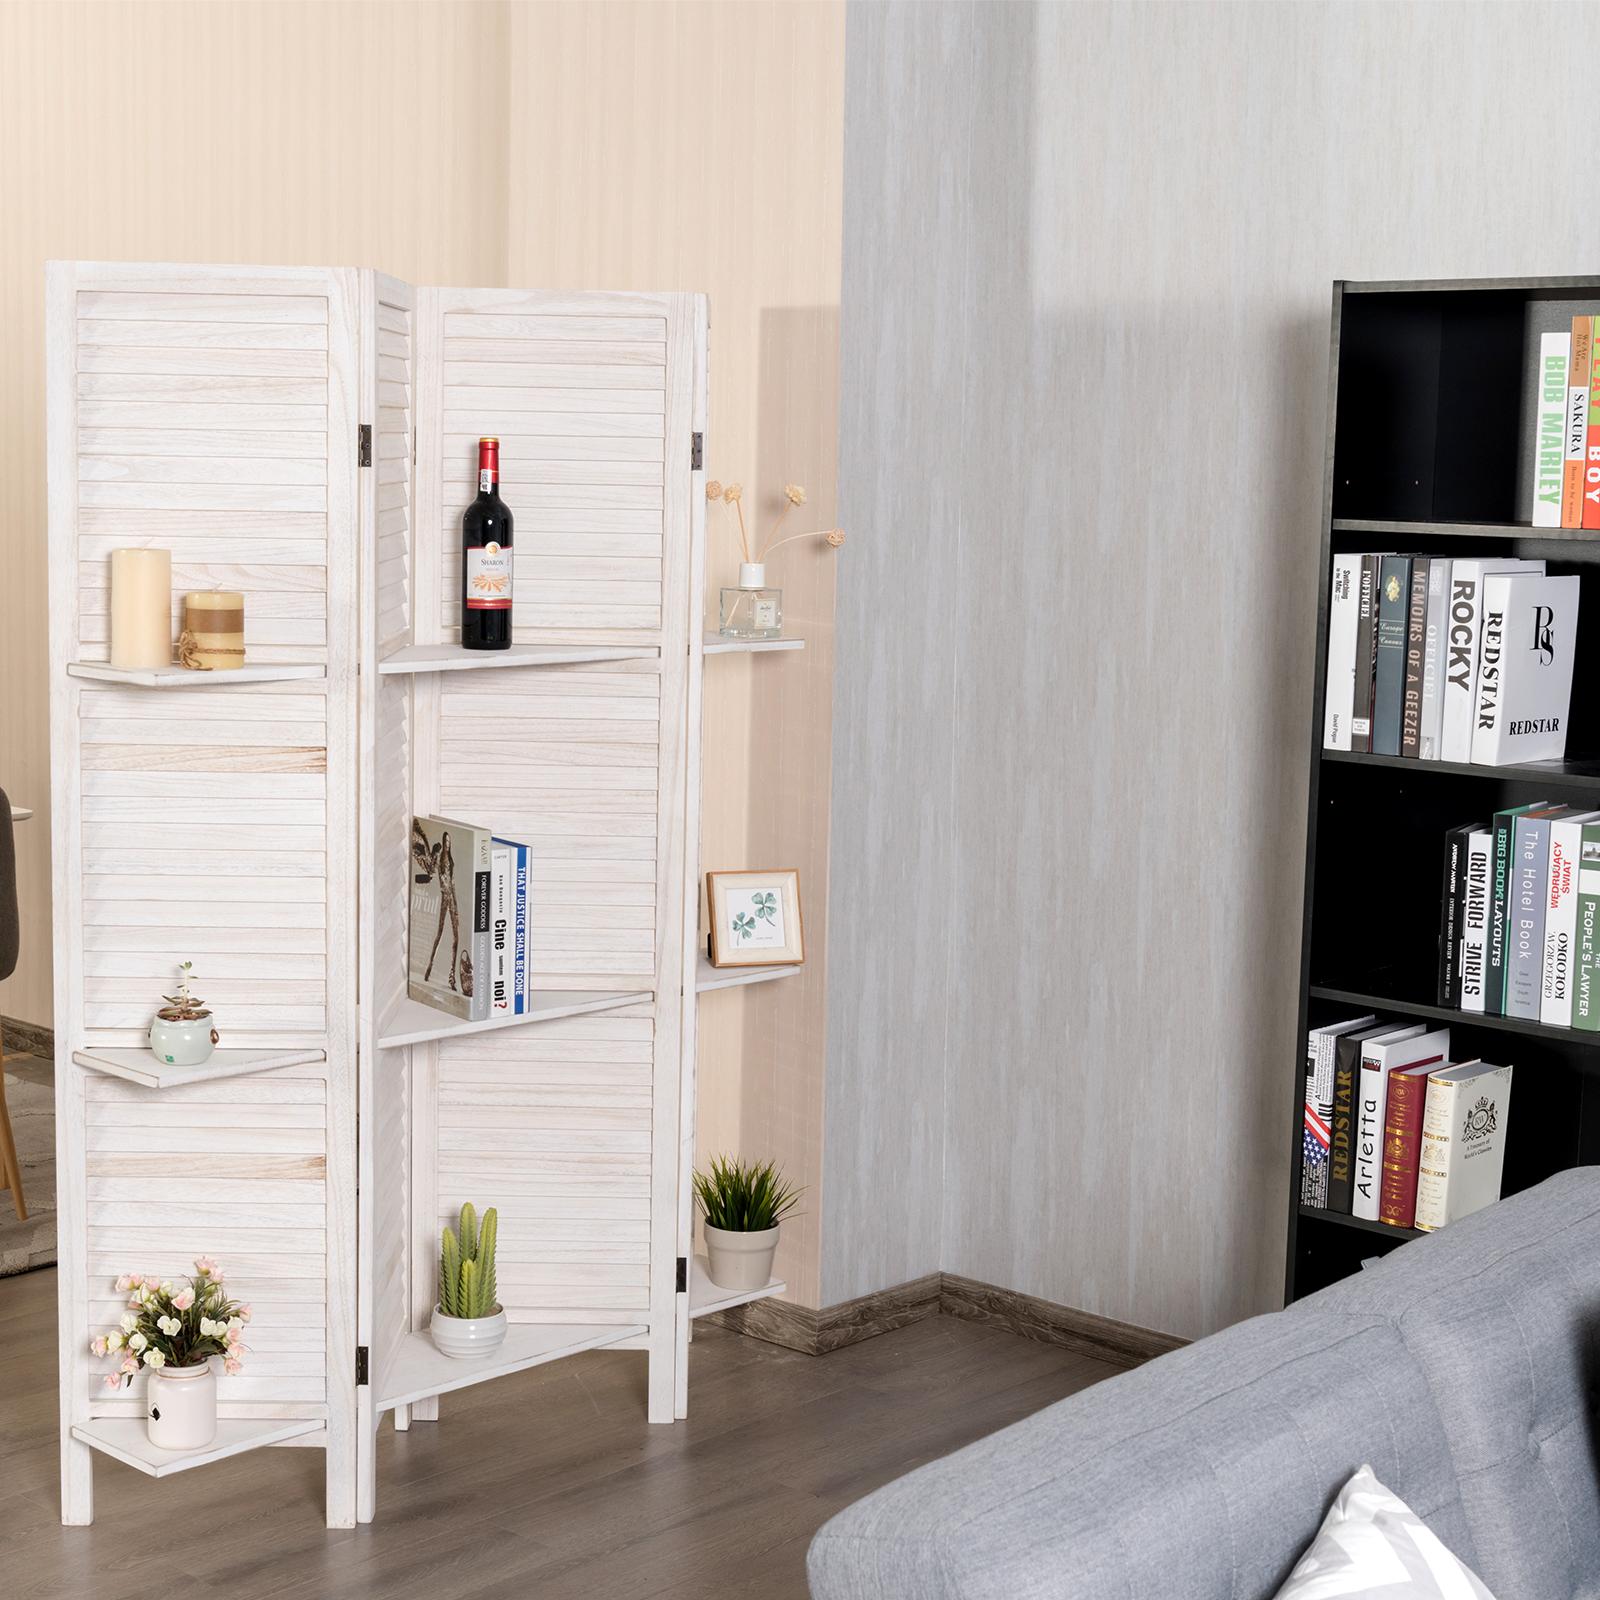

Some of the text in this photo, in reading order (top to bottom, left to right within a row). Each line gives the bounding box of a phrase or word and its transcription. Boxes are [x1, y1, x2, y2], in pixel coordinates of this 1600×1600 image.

[1538, 356, 1567, 505] BOB MARLEY
[1570, 394, 1585, 453] SAKURA
[1586, 446, 1600, 504] BOY
[1403, 571, 1427, 746] MEMOIRS OF A GEEZER
[1448, 580, 1476, 691] ROCKY
[1478, 611, 1504, 730] REDSTAR
[1509, 717, 1560, 736] REDSTAR
[1524, 831, 1538, 860] The
[1561, 859, 1572, 894] ŚWIAT
[1521, 868, 1537, 911] Hotel
[494, 919, 507, 950] Cine
[515, 867, 526, 995] THAT JUSTICE SHALL BE DONE
[1464, 851, 1487, 996] STRIVE FORWARD
[1492, 900, 1504, 967] LAYOUTS
[1519, 920, 1534, 960] Book
[1544, 944, 1555, 999] GRZEGORZ
[1555, 932, 1569, 1000] KOŁODKO
[1578, 901, 1596, 1017] PEOPLE'S LAWYER
[494, 980, 508, 1009] noi?
[1332, 1070, 1352, 1183] REDSTAR
[1357, 1099, 1377, 1199] Arletta
